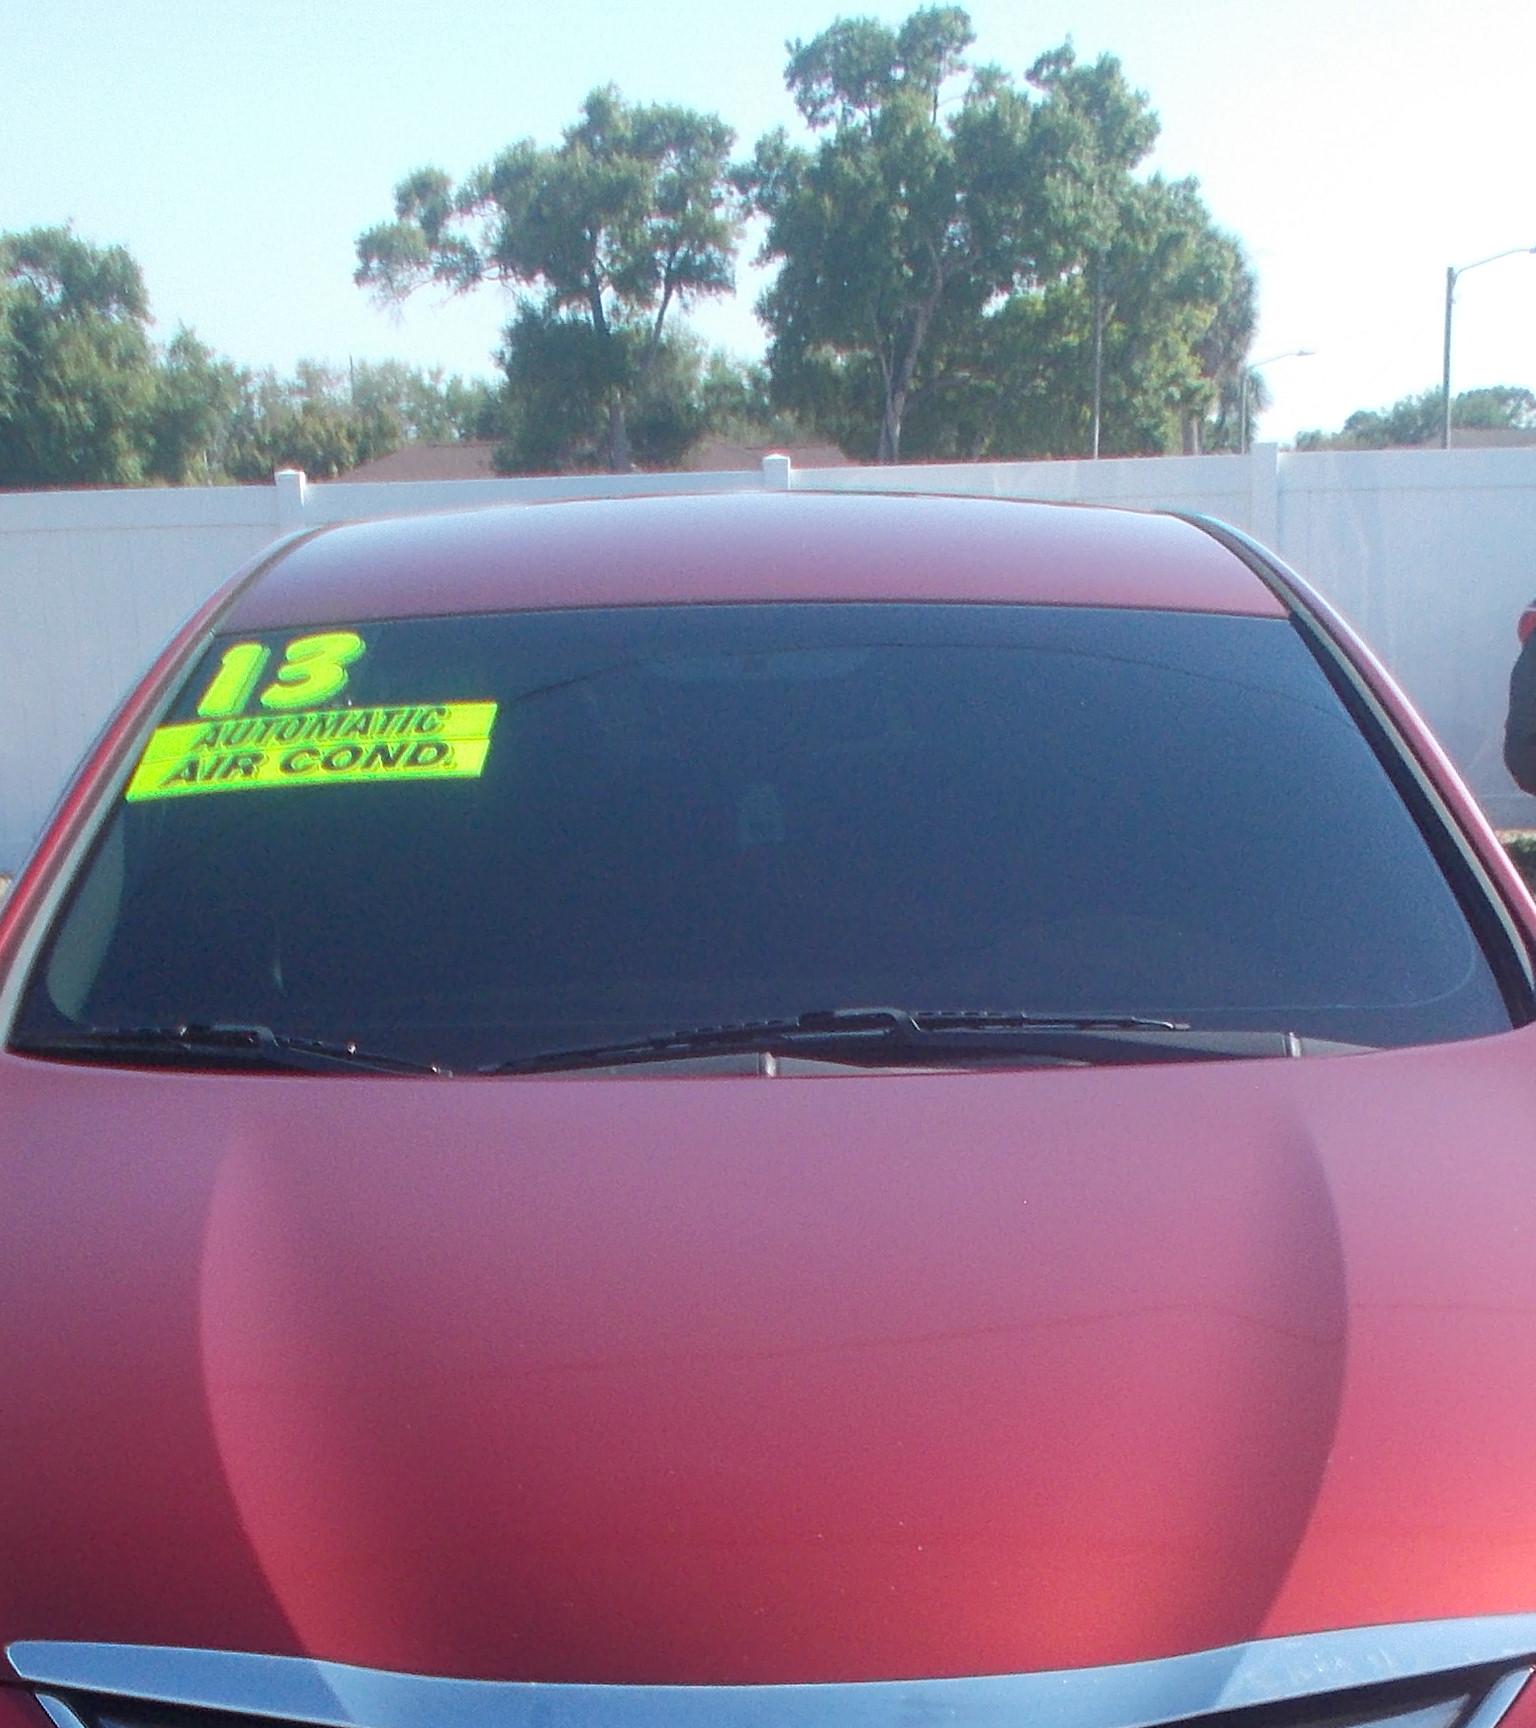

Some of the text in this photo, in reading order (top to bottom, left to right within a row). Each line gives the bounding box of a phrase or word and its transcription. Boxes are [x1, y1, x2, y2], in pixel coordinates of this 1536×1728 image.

[197, 633, 365, 717] 13
[194, 706, 449, 748] AUTOMATIC
[161, 751, 265, 787] AIR
